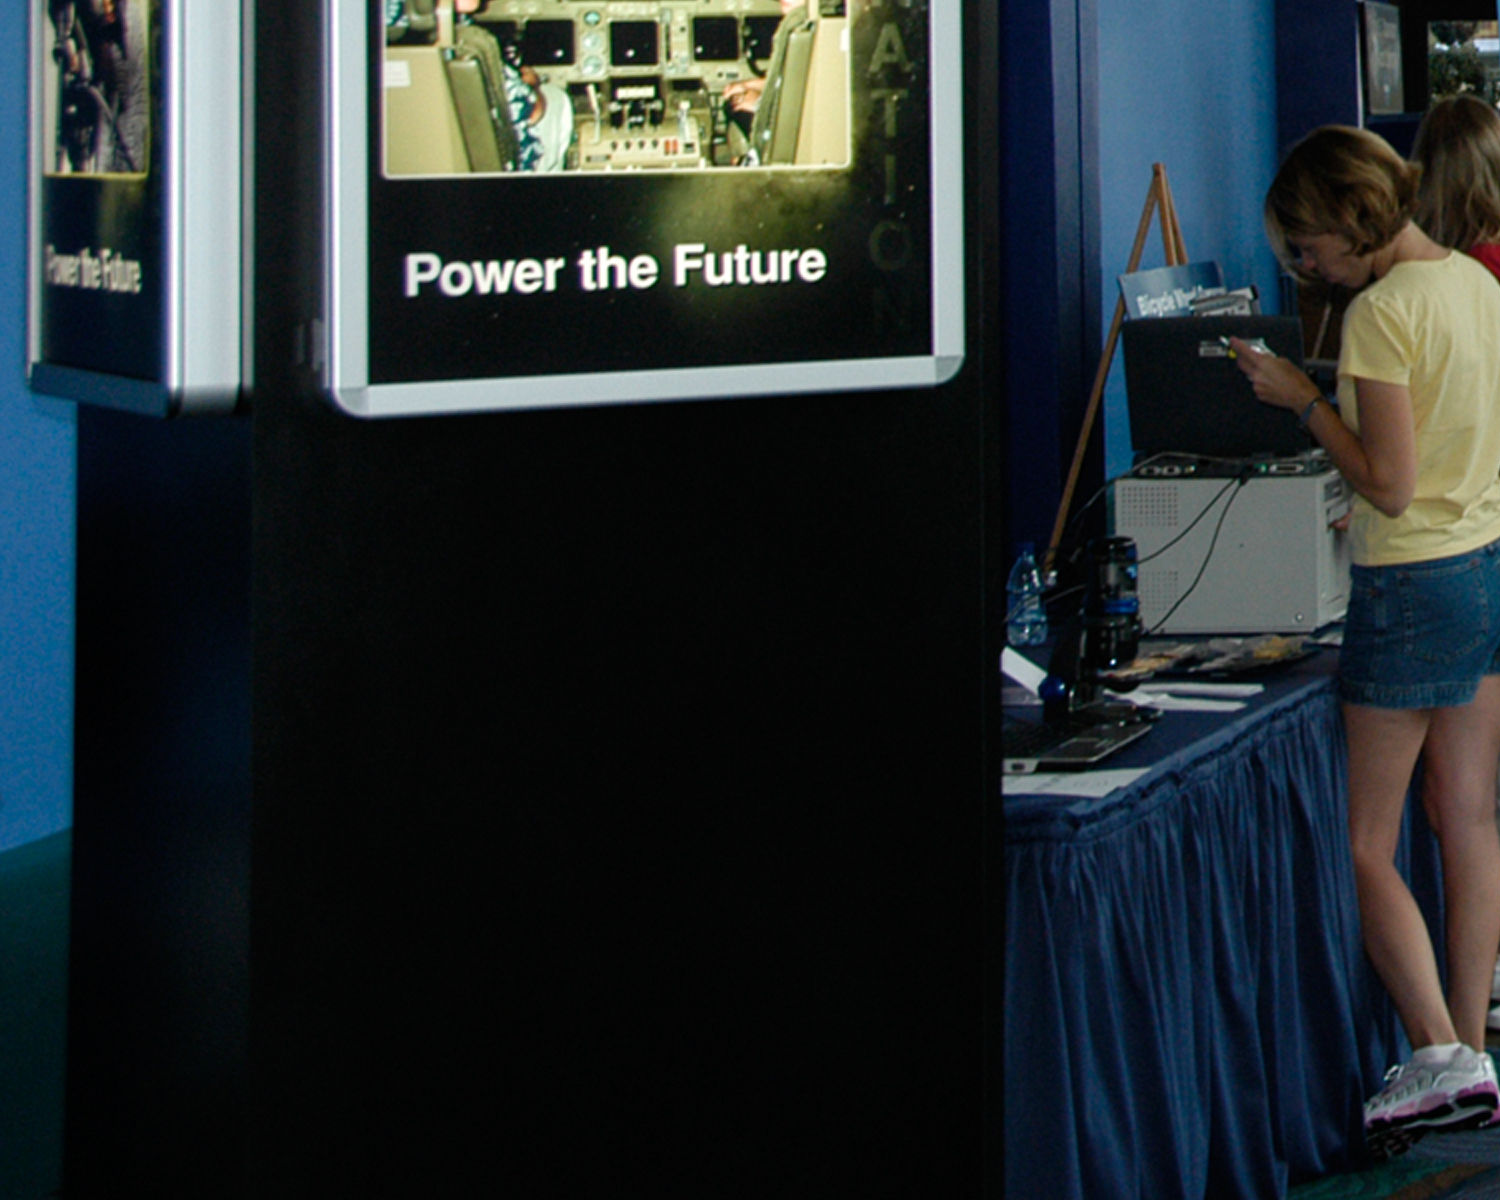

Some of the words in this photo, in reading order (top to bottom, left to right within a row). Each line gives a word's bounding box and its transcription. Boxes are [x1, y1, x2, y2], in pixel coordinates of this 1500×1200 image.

[406, 252, 565, 297] Power
[577, 246, 659, 291] the
[674, 243, 827, 286] Future
